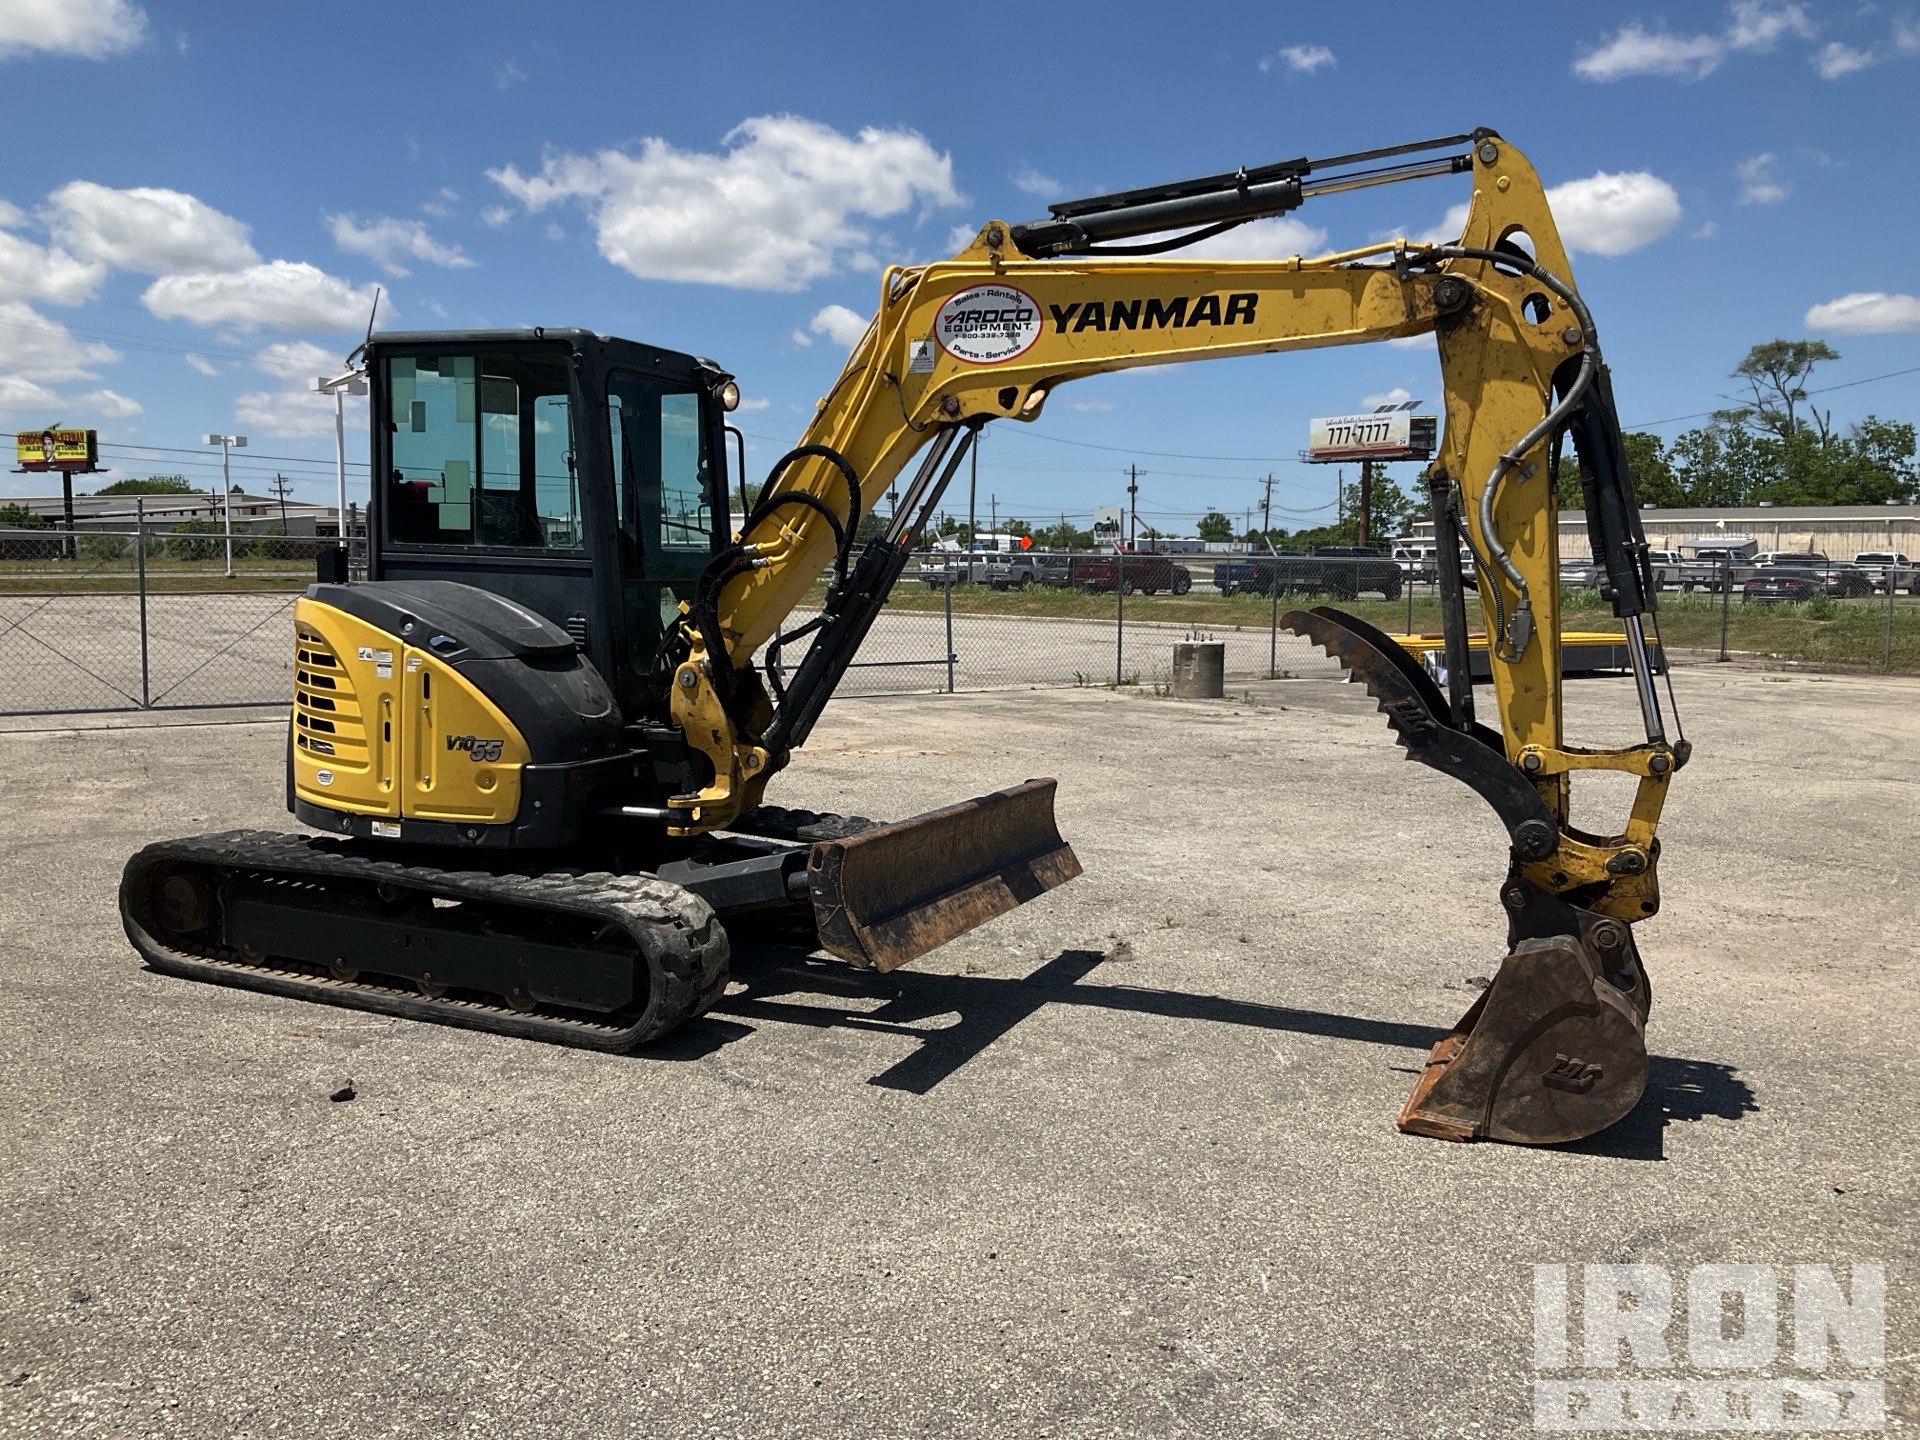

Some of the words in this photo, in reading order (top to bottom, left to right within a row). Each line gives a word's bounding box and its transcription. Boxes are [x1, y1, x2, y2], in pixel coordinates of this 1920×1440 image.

[954, 292, 980, 307] Sales
[987, 290, 1023, 304] Rentals
[1049, 292, 1259, 329] YANMAR
[953, 344, 979, 359] Parts
[985, 344, 1021, 359] Service
